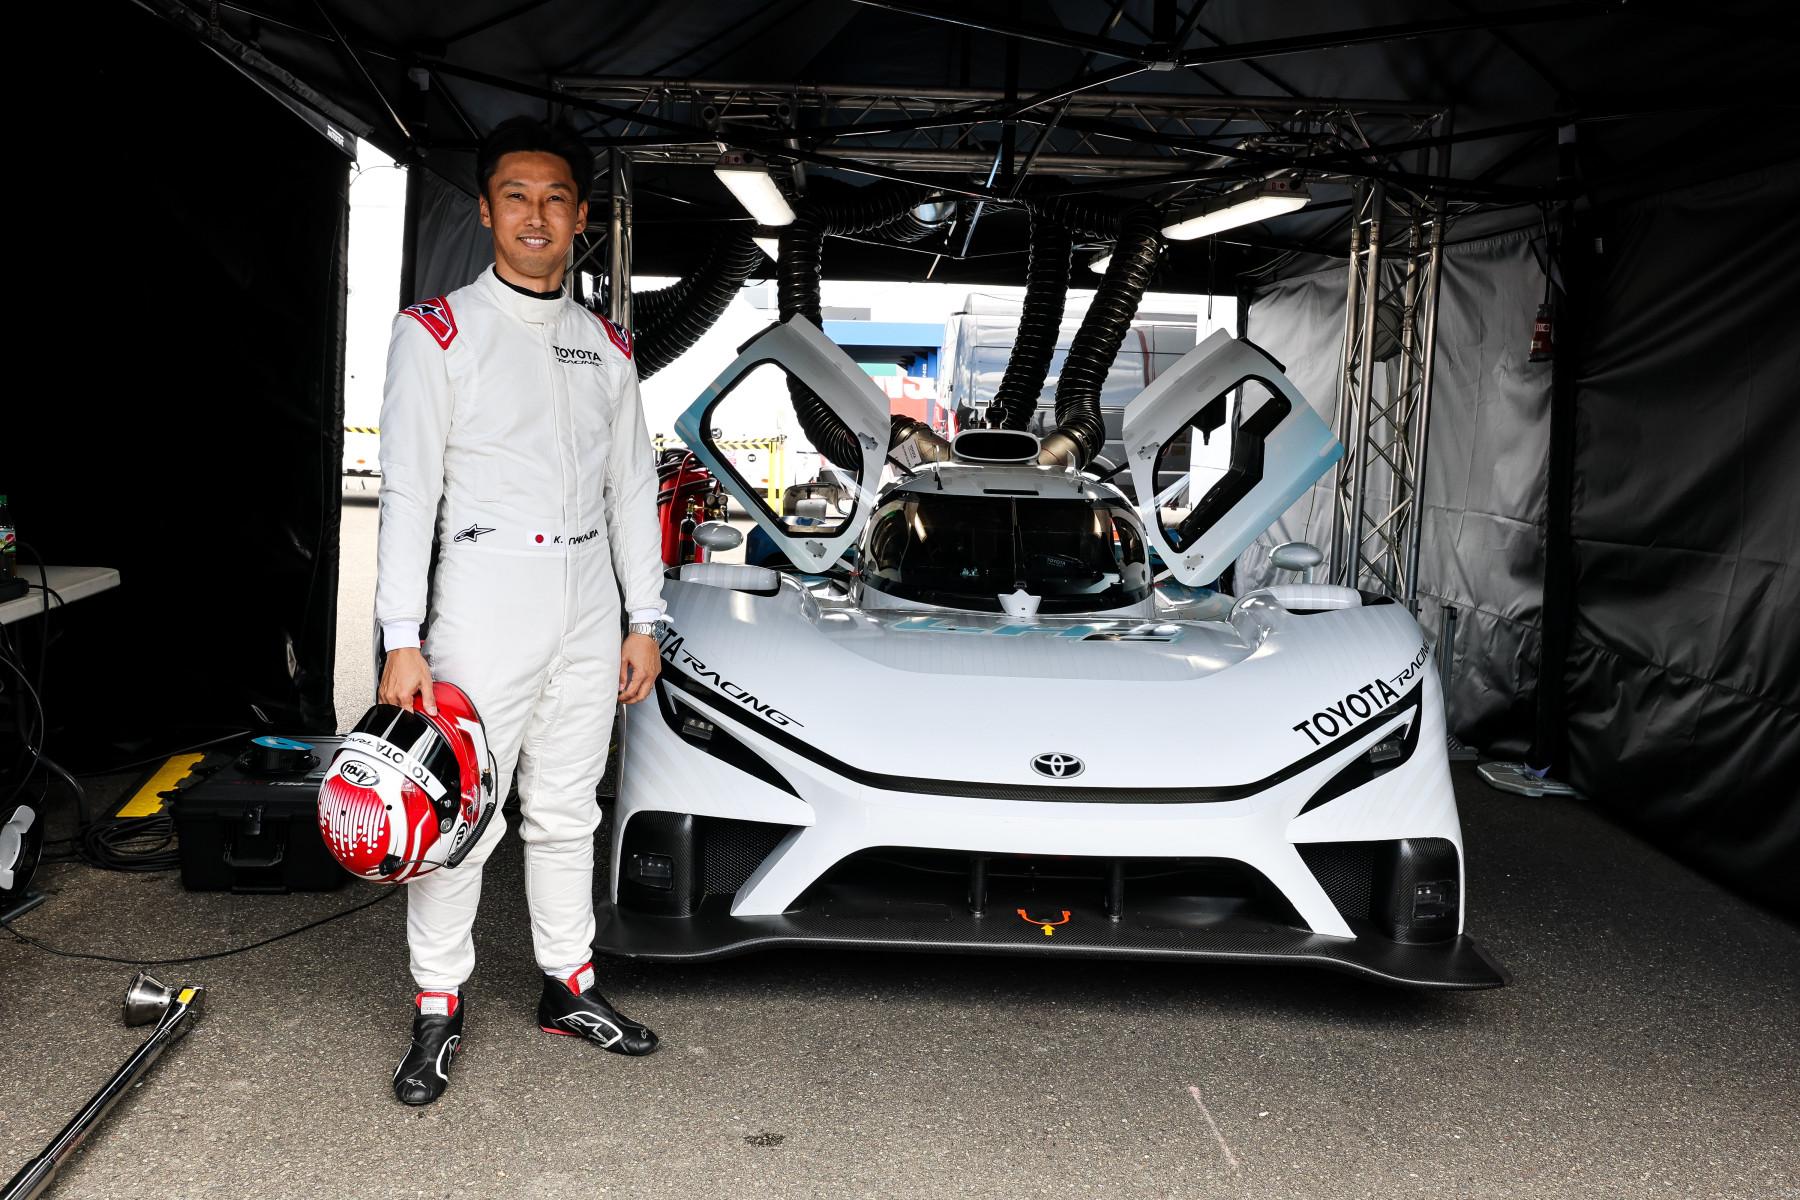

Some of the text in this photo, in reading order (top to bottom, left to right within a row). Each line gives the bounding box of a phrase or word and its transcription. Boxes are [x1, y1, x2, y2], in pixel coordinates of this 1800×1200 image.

[553, 346, 602, 361] TOYOTA
[682, 648, 805, 728] RACING
[1292, 678, 1400, 746] TOYOTA
[342, 763, 377, 784] Arai
